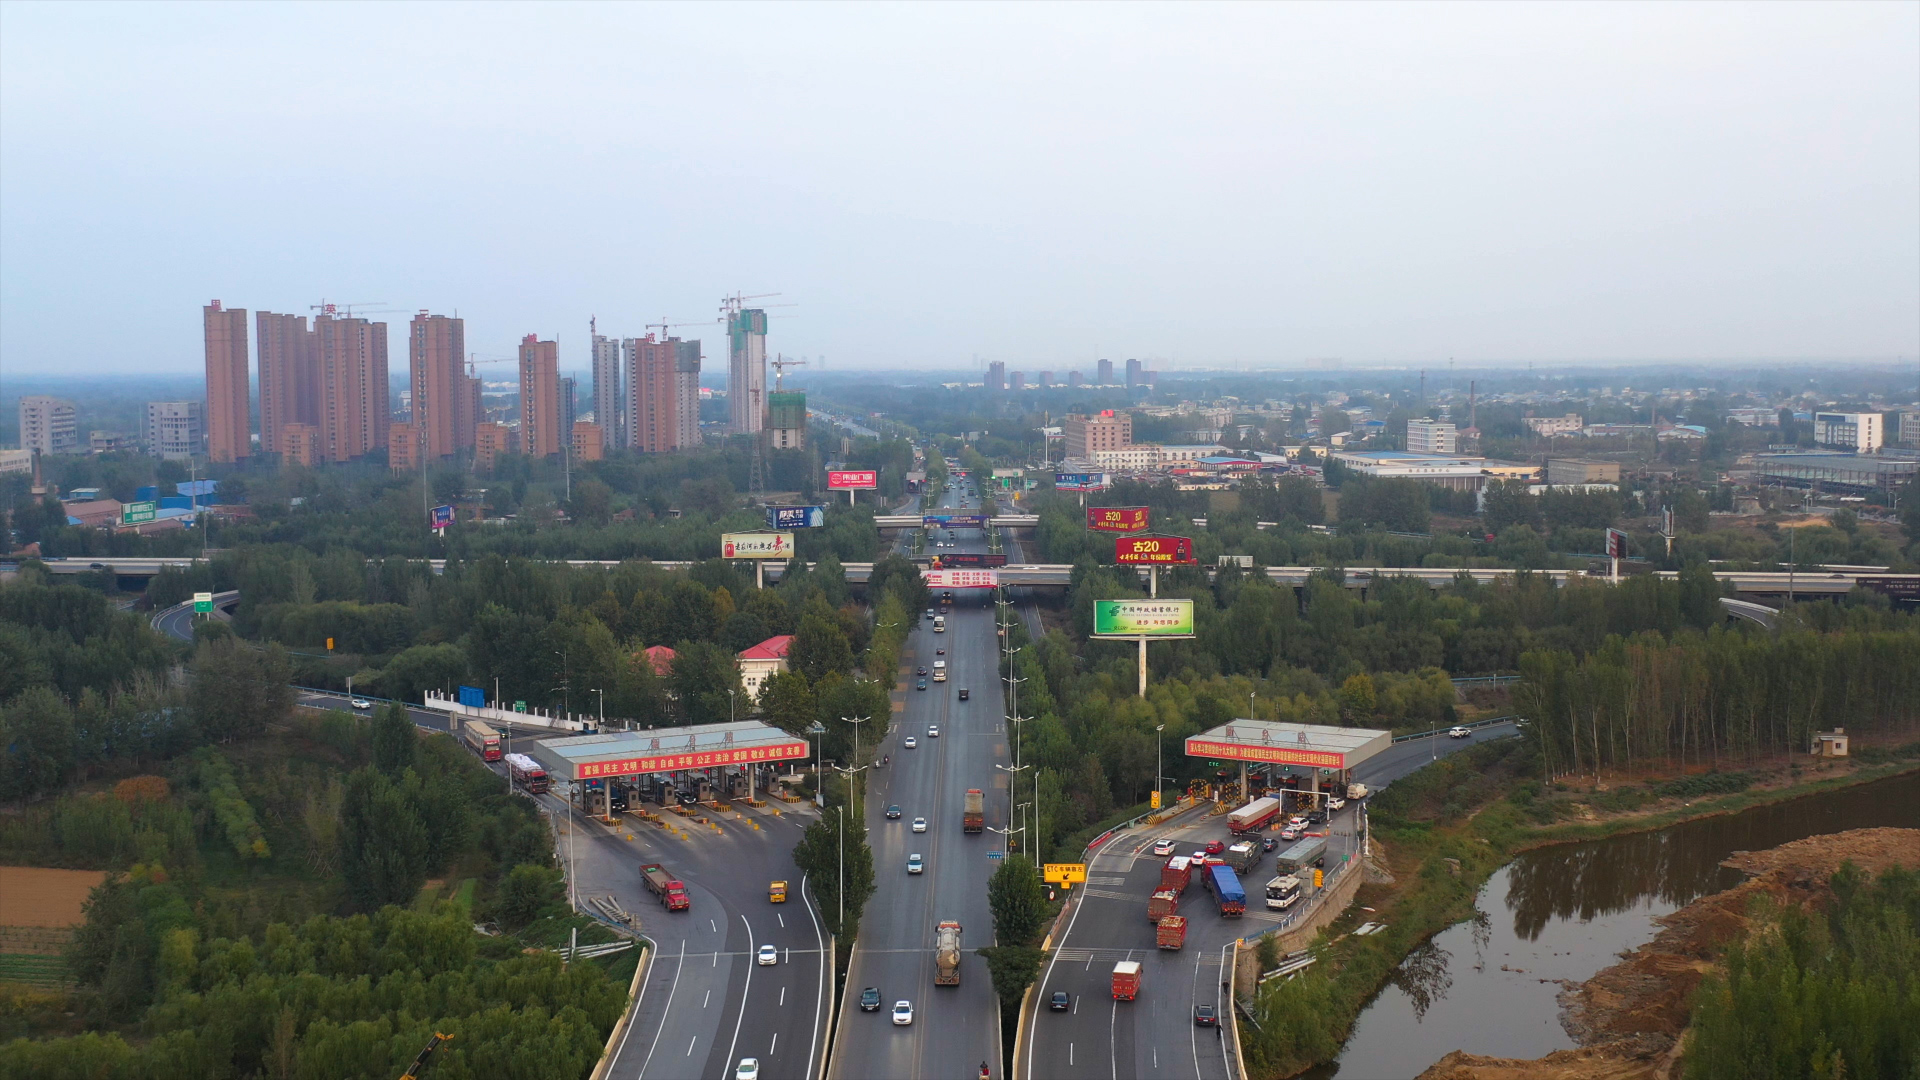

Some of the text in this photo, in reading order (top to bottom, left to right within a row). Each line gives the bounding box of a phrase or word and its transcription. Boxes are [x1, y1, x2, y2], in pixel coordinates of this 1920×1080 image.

[325, 304, 336, 314] 英
[1105, 511, 1121, 522] 古20
[1132, 540, 1160, 552] 古20
[1122, 606, 1180, 614] 中国邮政储蓄银行
[584, 746, 800, 776] 富强 民主 文明 和谐 自由 平等 公正 法治 爱国 敬业 诚信 友善
